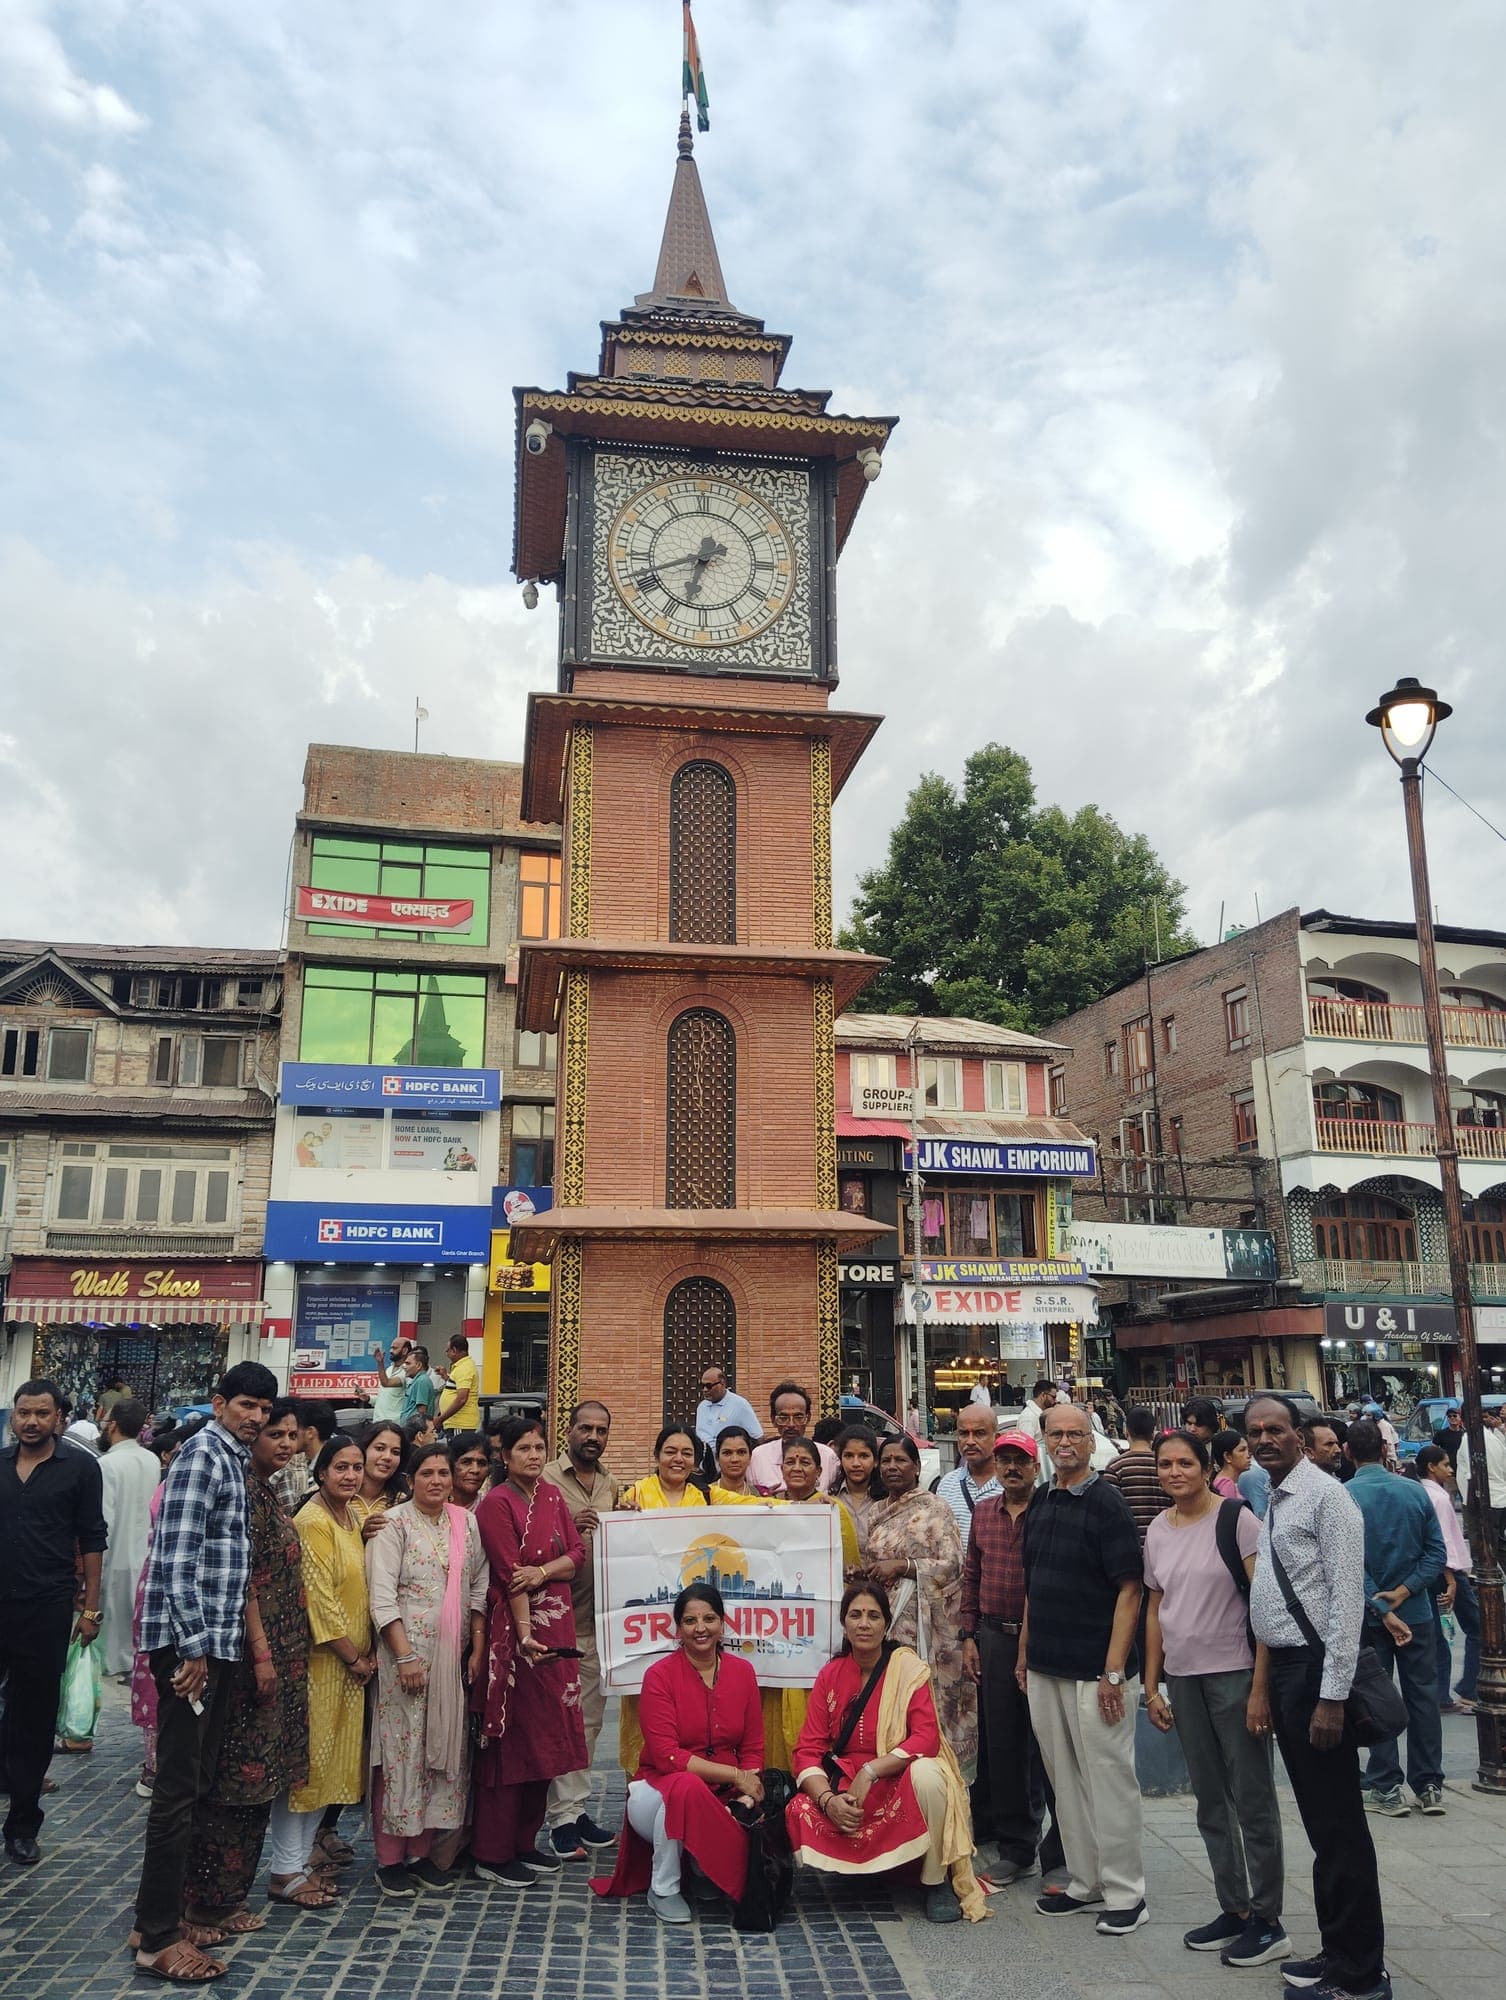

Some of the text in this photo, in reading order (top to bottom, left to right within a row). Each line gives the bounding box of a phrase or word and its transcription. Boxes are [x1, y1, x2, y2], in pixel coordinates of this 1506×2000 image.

[311, 893, 369, 913] EXIDE
[405, 1082, 478, 1093] HDFC BANK
[920, 1143, 1088, 1171] JK SHAWL EMPORIUM
[346, 1226, 434, 1238] HDFC BANK
[933, 1264, 1083, 1281] JK SHAWL EMPORIUM
[70, 1269, 201, 1297] Walk Shoes
[935, 1290, 1021, 1313] EXIDE
[1345, 1307, 1416, 1331] U & I
[1383, 1332, 1453, 1341] Academy Of Style
